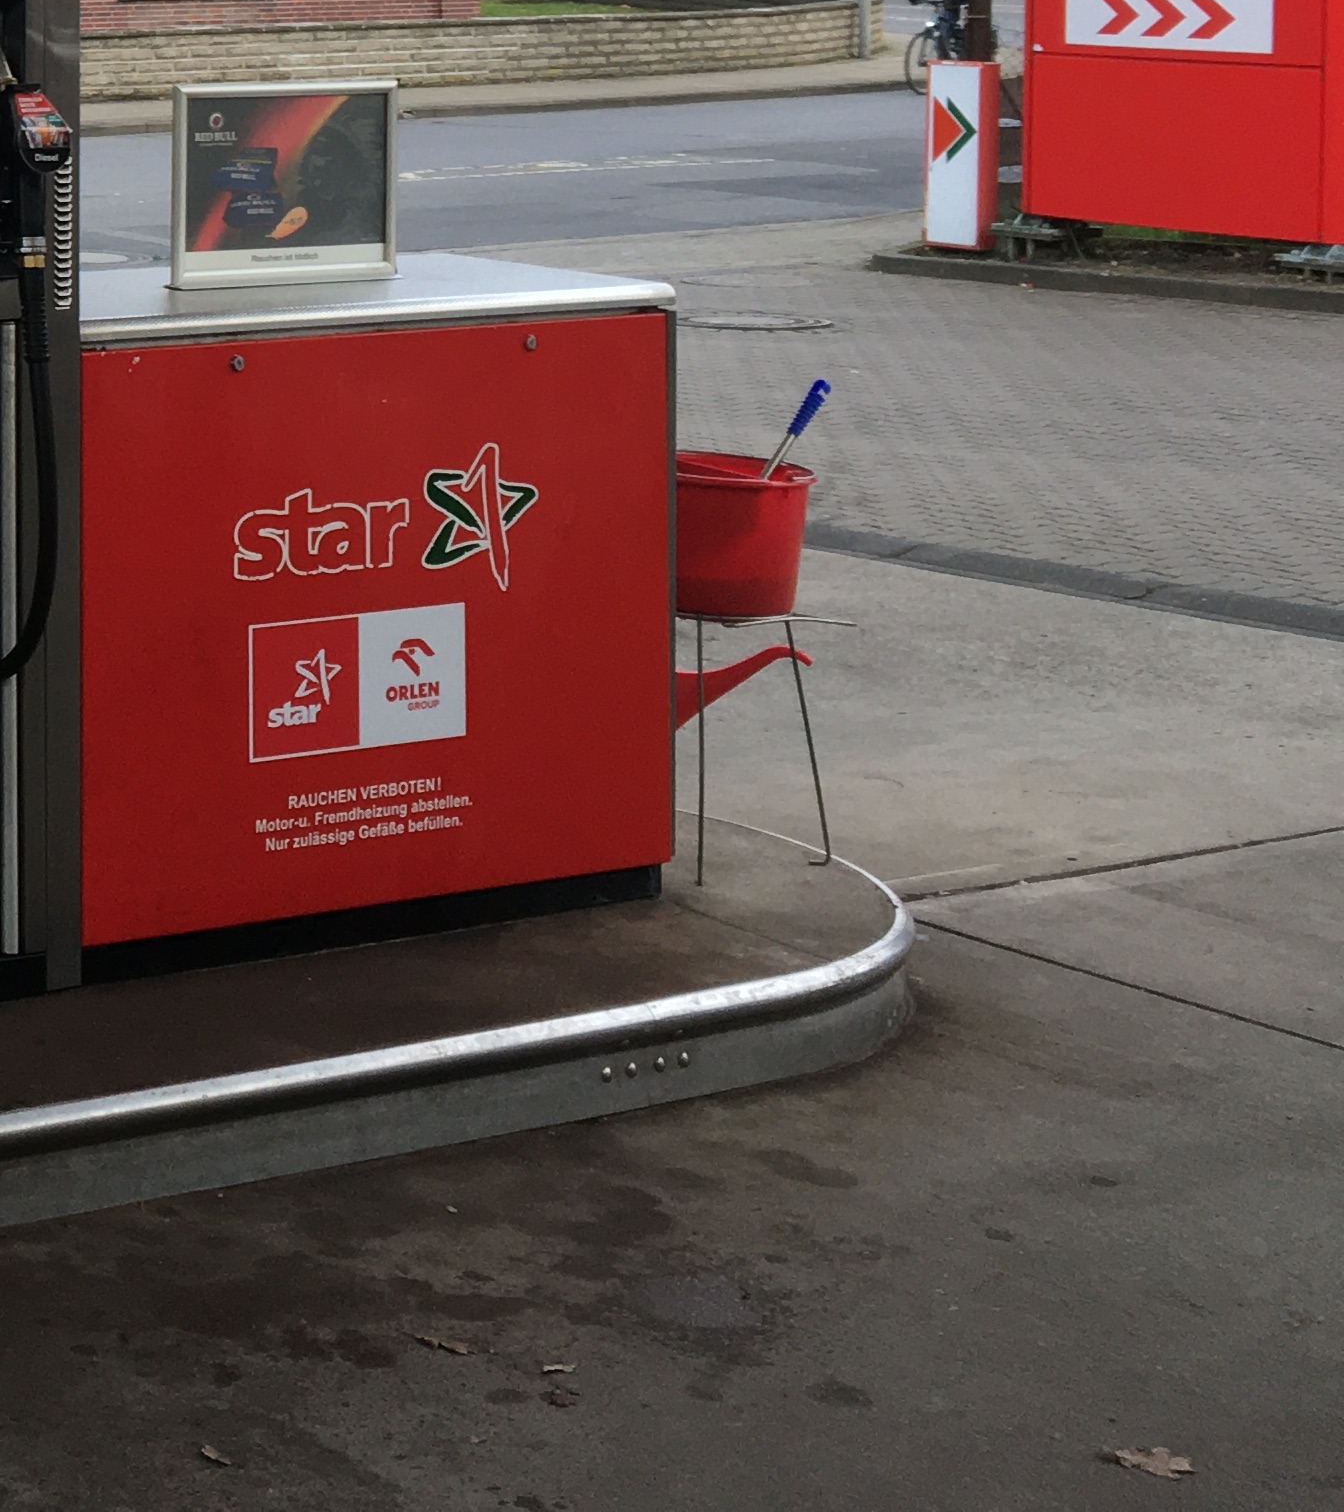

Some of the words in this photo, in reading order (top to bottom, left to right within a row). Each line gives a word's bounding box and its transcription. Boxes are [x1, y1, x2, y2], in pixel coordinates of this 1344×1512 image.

[34, 153, 59, 162] Diesel
[233, 488, 410, 582] star
[385, 681, 441, 702] ORLEN
[407, 699, 441, 711] GROUP
[267, 699, 321, 729] star
[288, 788, 357, 810] RAUCHEN
[360, 776, 442, 800] VERBOTEN!
[314, 802, 408, 826] Fremdheizung
[410, 794, 473, 813] abstellen.
[265, 837, 289, 852] Nur
[292, 828, 355, 848] zulässige
[358, 821, 405, 839] Gefäße
[408, 814, 464, 833] befüllen.
